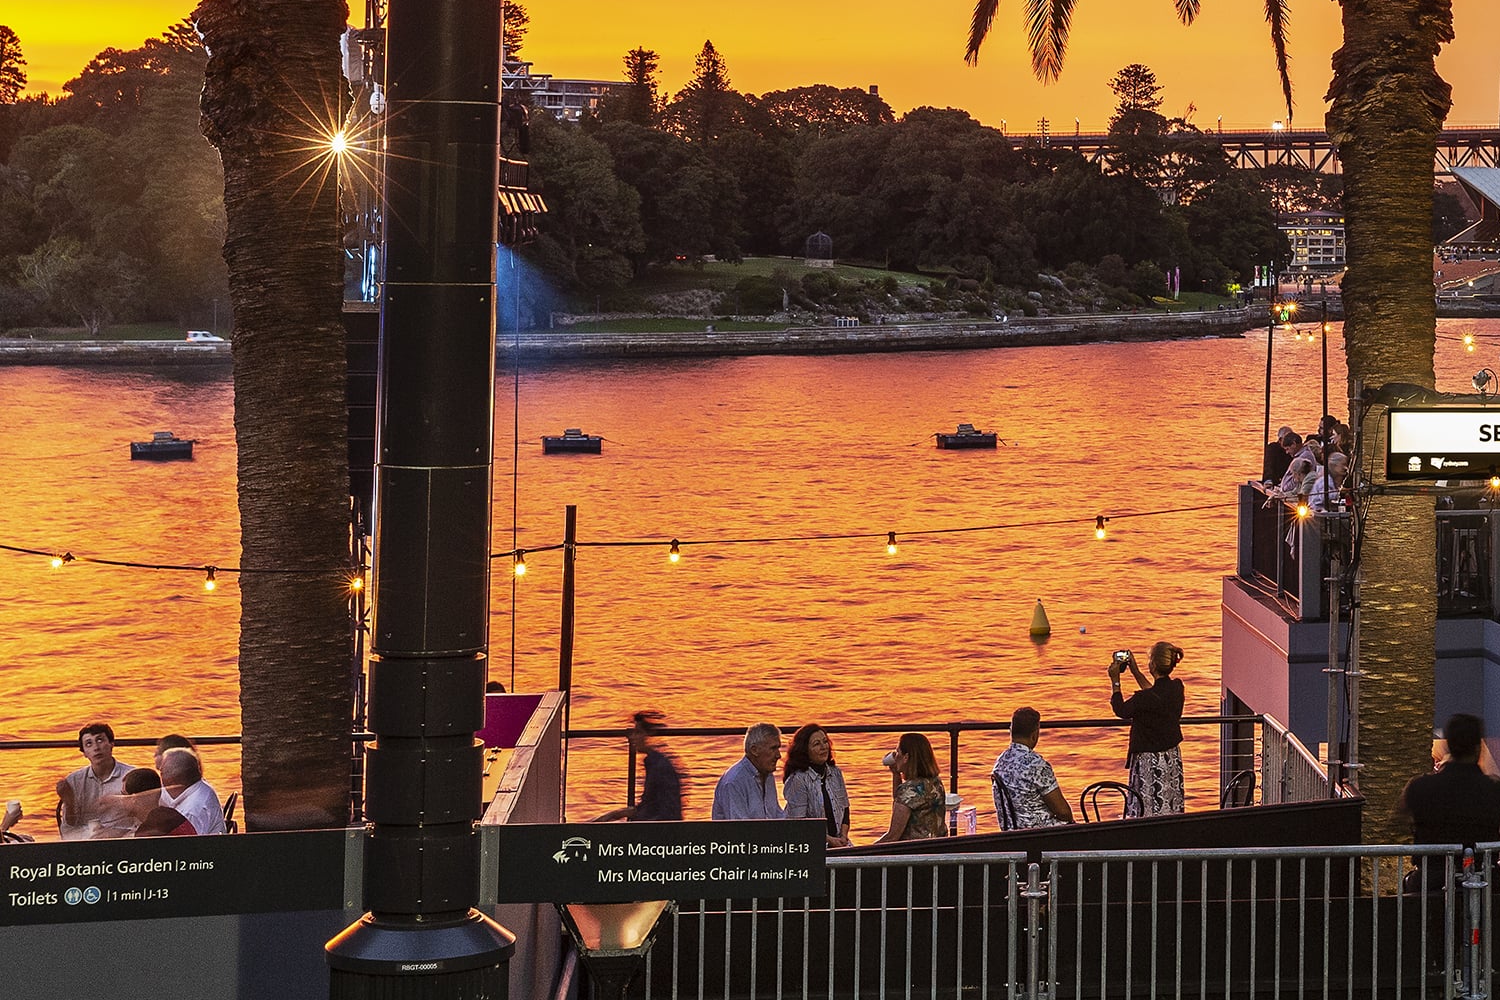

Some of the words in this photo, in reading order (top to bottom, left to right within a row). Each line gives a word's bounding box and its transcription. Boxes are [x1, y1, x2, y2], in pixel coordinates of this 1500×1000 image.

[598, 844, 624, 856] Mrs
[628, 842, 706, 858] Macquaries
[710, 841, 745, 855] Point
[752, 845, 758, 854] 3
[760, 844, 784, 854] mins
[788, 844, 810, 853] E-13
[10, 864, 51, 882] Royal
[56, 861, 113, 877] Botanic
[117, 858, 172, 874] Garden
[180, 861, 186, 870] 2
[189, 859, 214, 871] mins
[598, 870, 624, 882] Mrs
[628, 868, 706, 884] Macquaries
[709, 867, 745, 881] Chair
[751, 871, 758, 880] 4
[760, 869, 784, 880] mins
[788, 869, 809, 879] F-14
[8, 892, 58, 907] Toilets
[112, 891, 117, 901] 1
[121, 890, 141, 901] min
[147, 889, 169, 899] J-13
